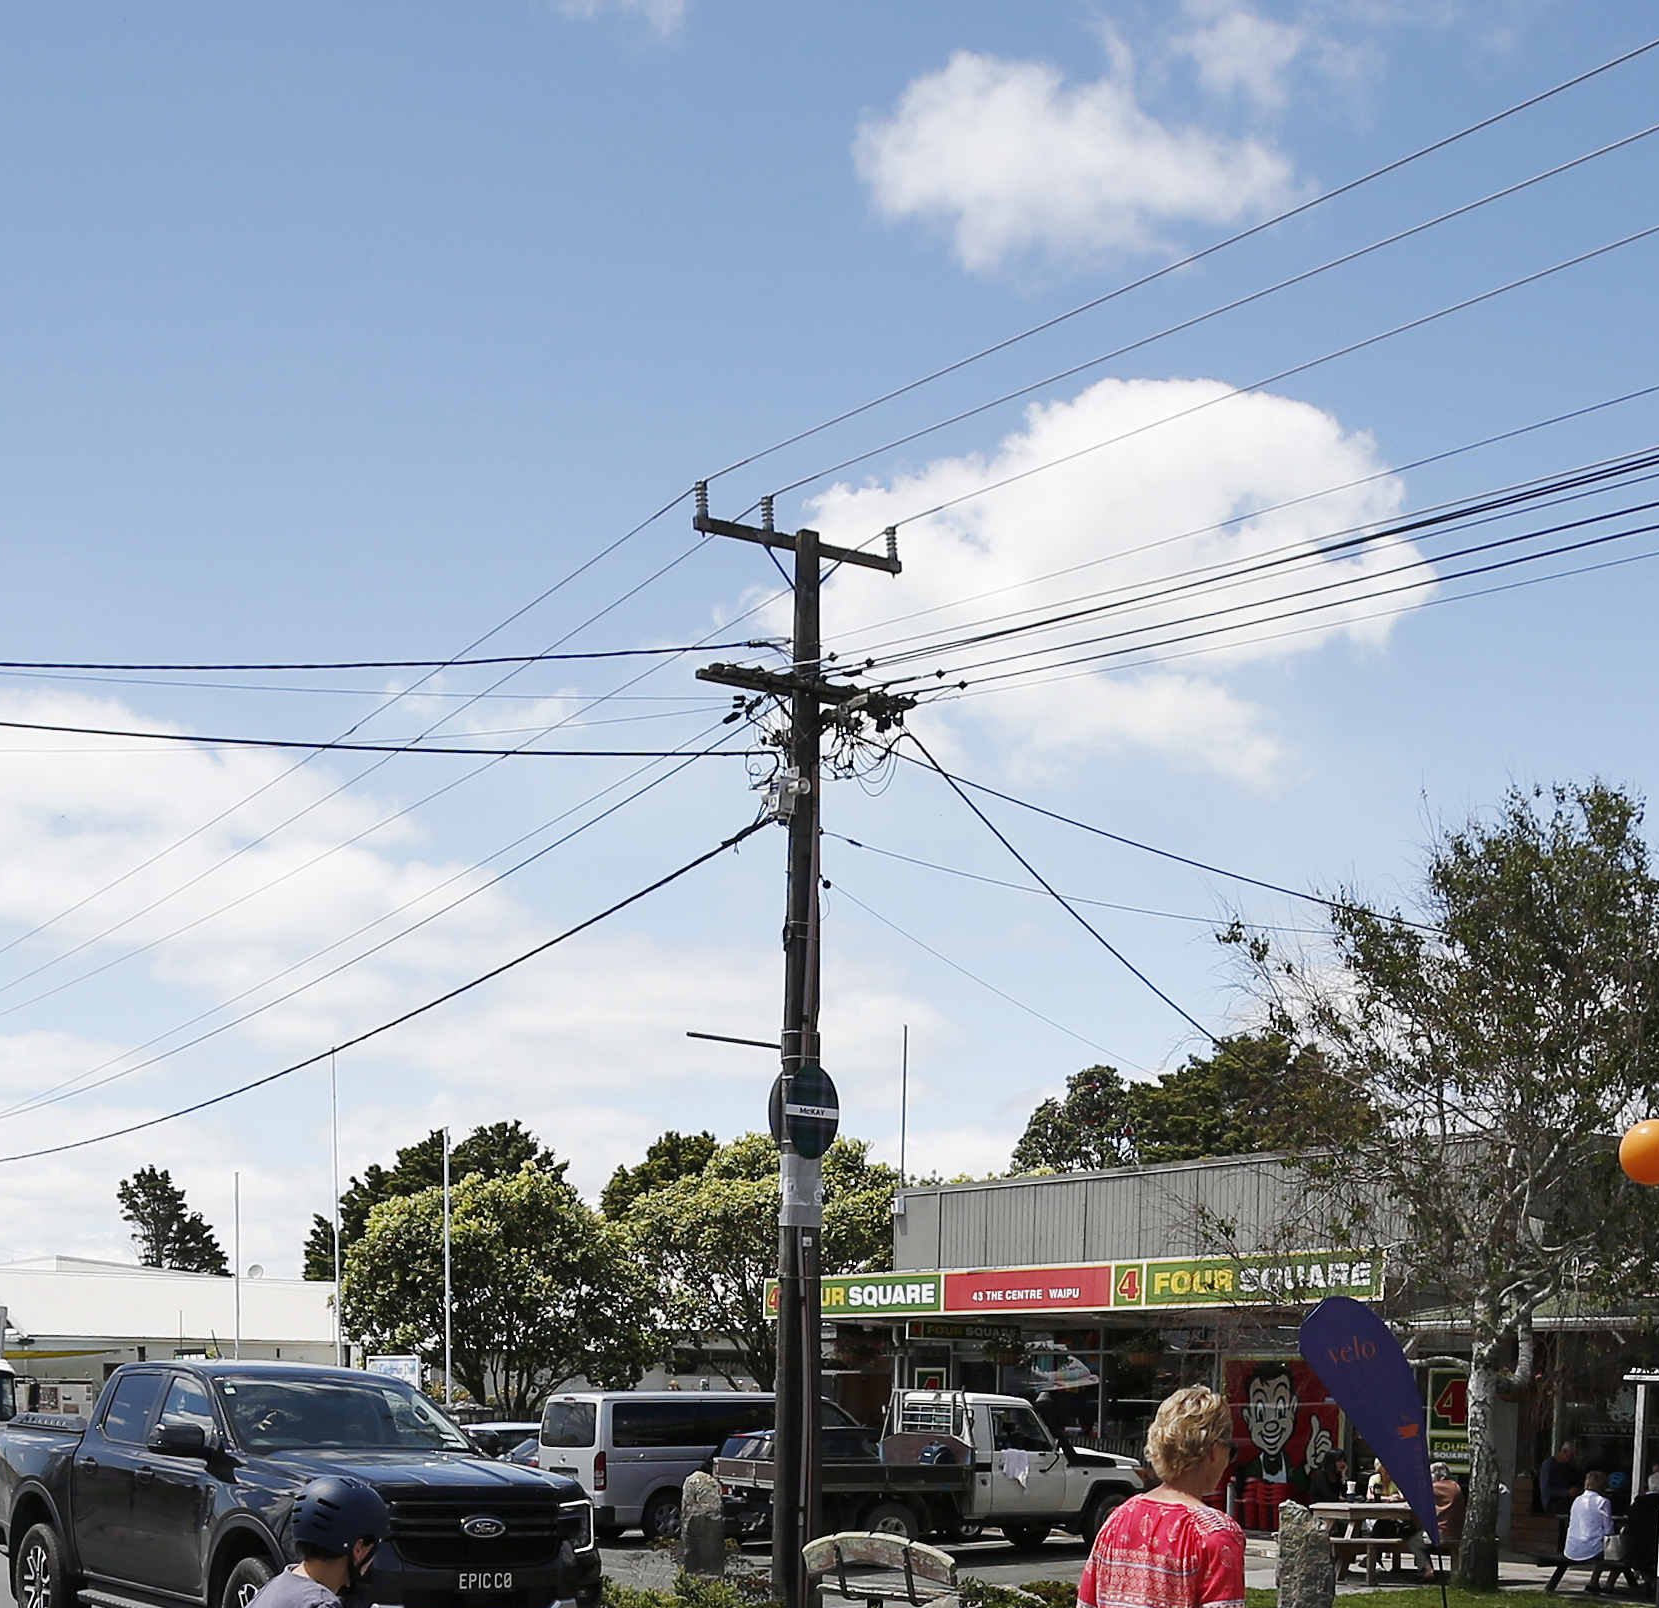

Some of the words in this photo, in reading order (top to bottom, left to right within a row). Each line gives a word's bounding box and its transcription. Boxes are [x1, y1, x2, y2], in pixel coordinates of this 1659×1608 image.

[799, 1106, 825, 1117] McKAY
[1117, 1268, 1140, 1301] 4
[1153, 1269, 1234, 1295] FOUR
[1239, 1261, 1372, 1292] SQUARE
[821, 1287, 846, 1307] UR
[848, 1283, 935, 1308] SQUARE
[972, 1291, 984, 1302] 43
[985, 1290, 1004, 1301] THE
[1005, 1289, 1043, 1301] CENTRE
[1049, 1288, 1080, 1300] WAIPU
[927, 1325, 963, 1336] FOUR
[965, 1326, 1017, 1338] SQUARE
[1328, 1336, 1378, 1364] velo
[1434, 1379, 1468, 1426] 4
[1434, 1442, 1469, 1451] FOUR
[1434, 1452, 1471, 1460] SQUARE
[475, 1523, 497, 1533] Ford
[459, 1573, 492, 1590] EPIC
